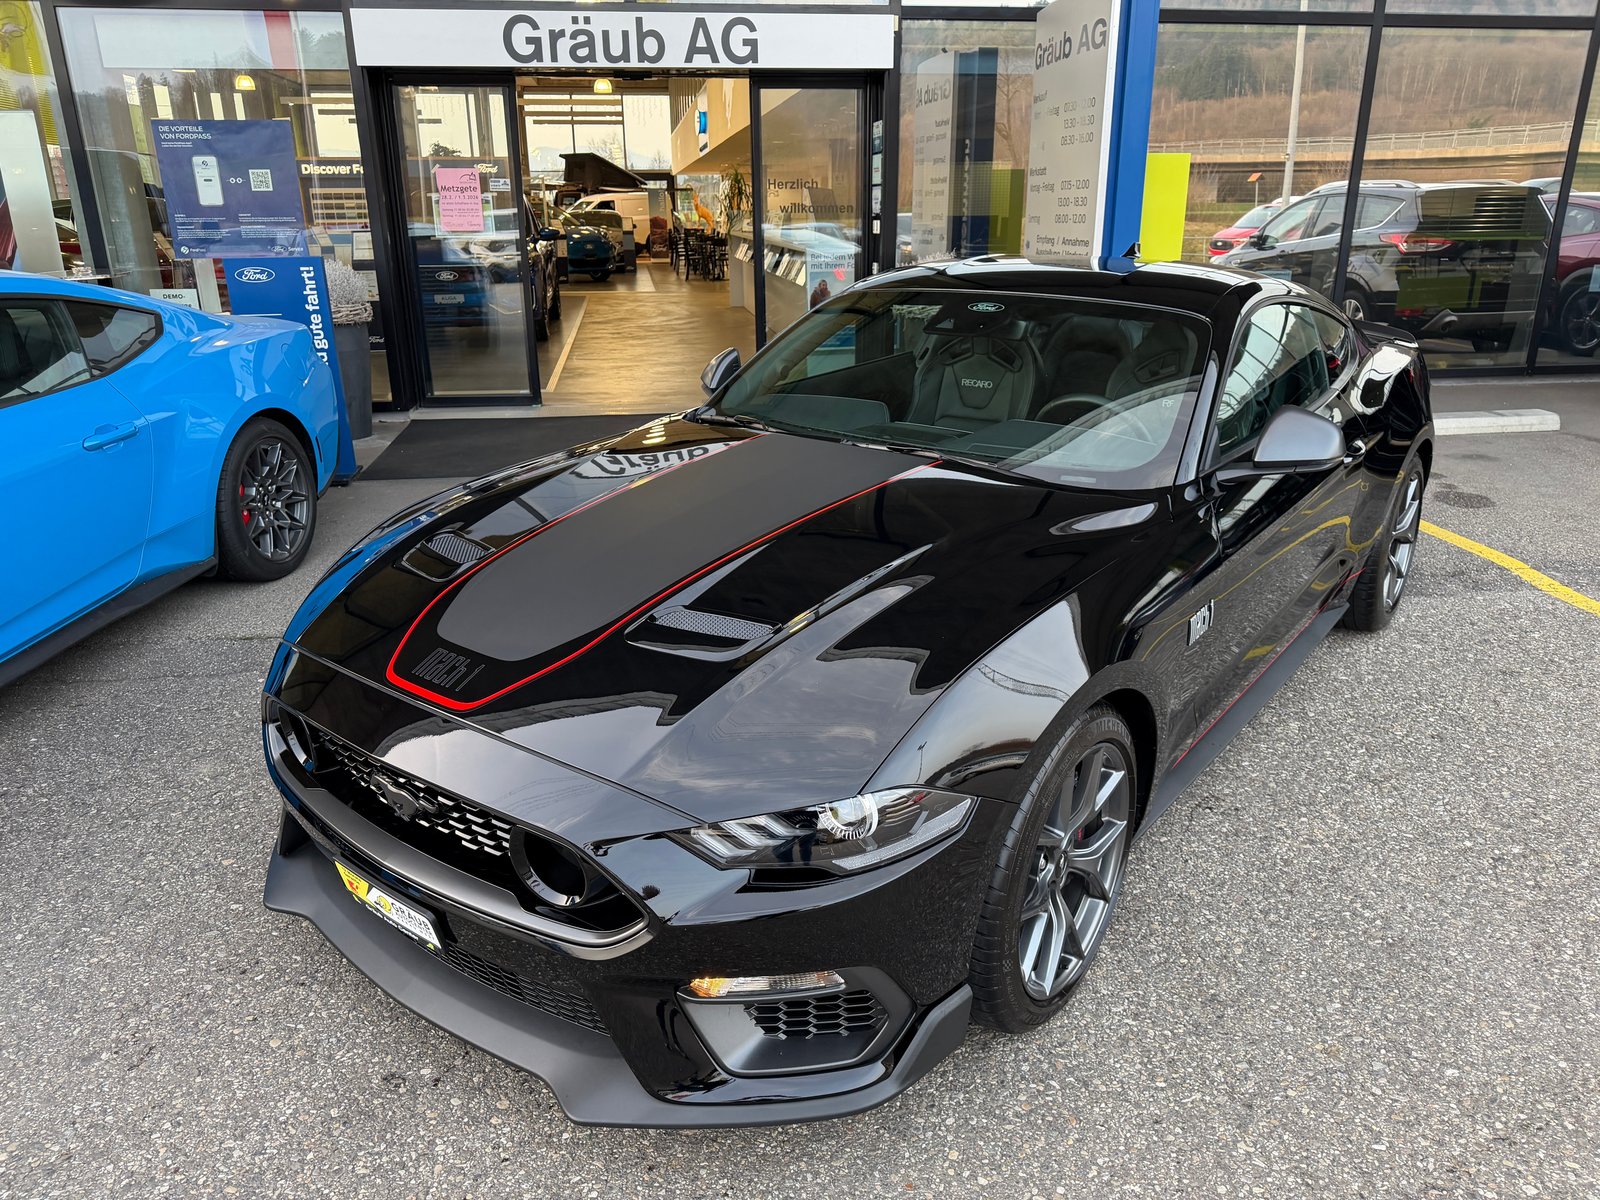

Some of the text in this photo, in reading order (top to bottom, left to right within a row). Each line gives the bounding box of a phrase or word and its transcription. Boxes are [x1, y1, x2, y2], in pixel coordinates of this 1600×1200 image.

[502, 14, 758, 64] Gräub AG
[1035, 18, 1107, 70] Gräub AG
[301, 164, 350, 174] Discover
[478, 163, 498, 173] Ford
[441, 184, 477, 195] Metzgete
[768, 179, 818, 190] Herzlich
[1076, 179, 1090, 189] 12.00
[780, 203, 854, 214] willkommen
[1062, 237, 1089, 247] Annahme
[810, 262, 822, 270] mit
[824, 262, 845, 270] Ihrem
[242, 269, 268, 281] Ford
[300, 266, 320, 311] fahrt!
[310, 314, 328, 350] gute
[961, 378, 993, 389] RECARO
